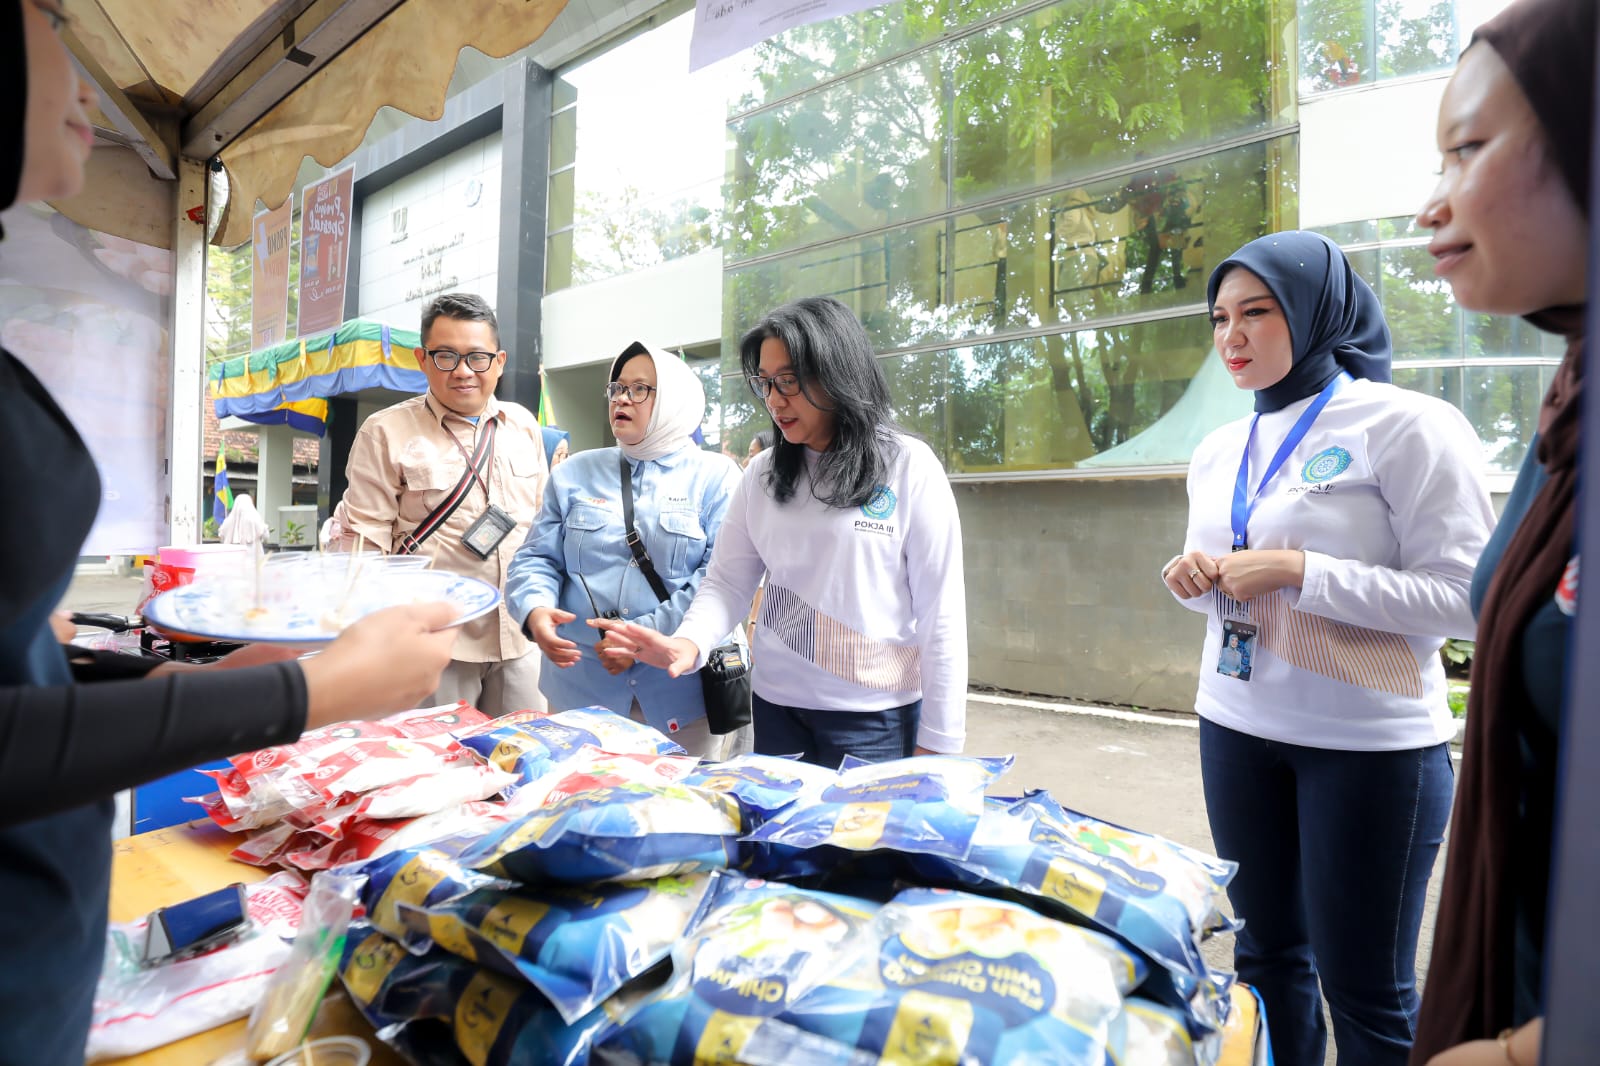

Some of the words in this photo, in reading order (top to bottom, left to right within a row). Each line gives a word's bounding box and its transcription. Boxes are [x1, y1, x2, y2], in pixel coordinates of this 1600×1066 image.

[854, 520, 884, 531] POKJA
[886, 525, 894, 533] III
[706, 967, 784, 1003] Chikuw
[988, 964, 1042, 994] With
[991, 982, 1044, 1011] Fish
